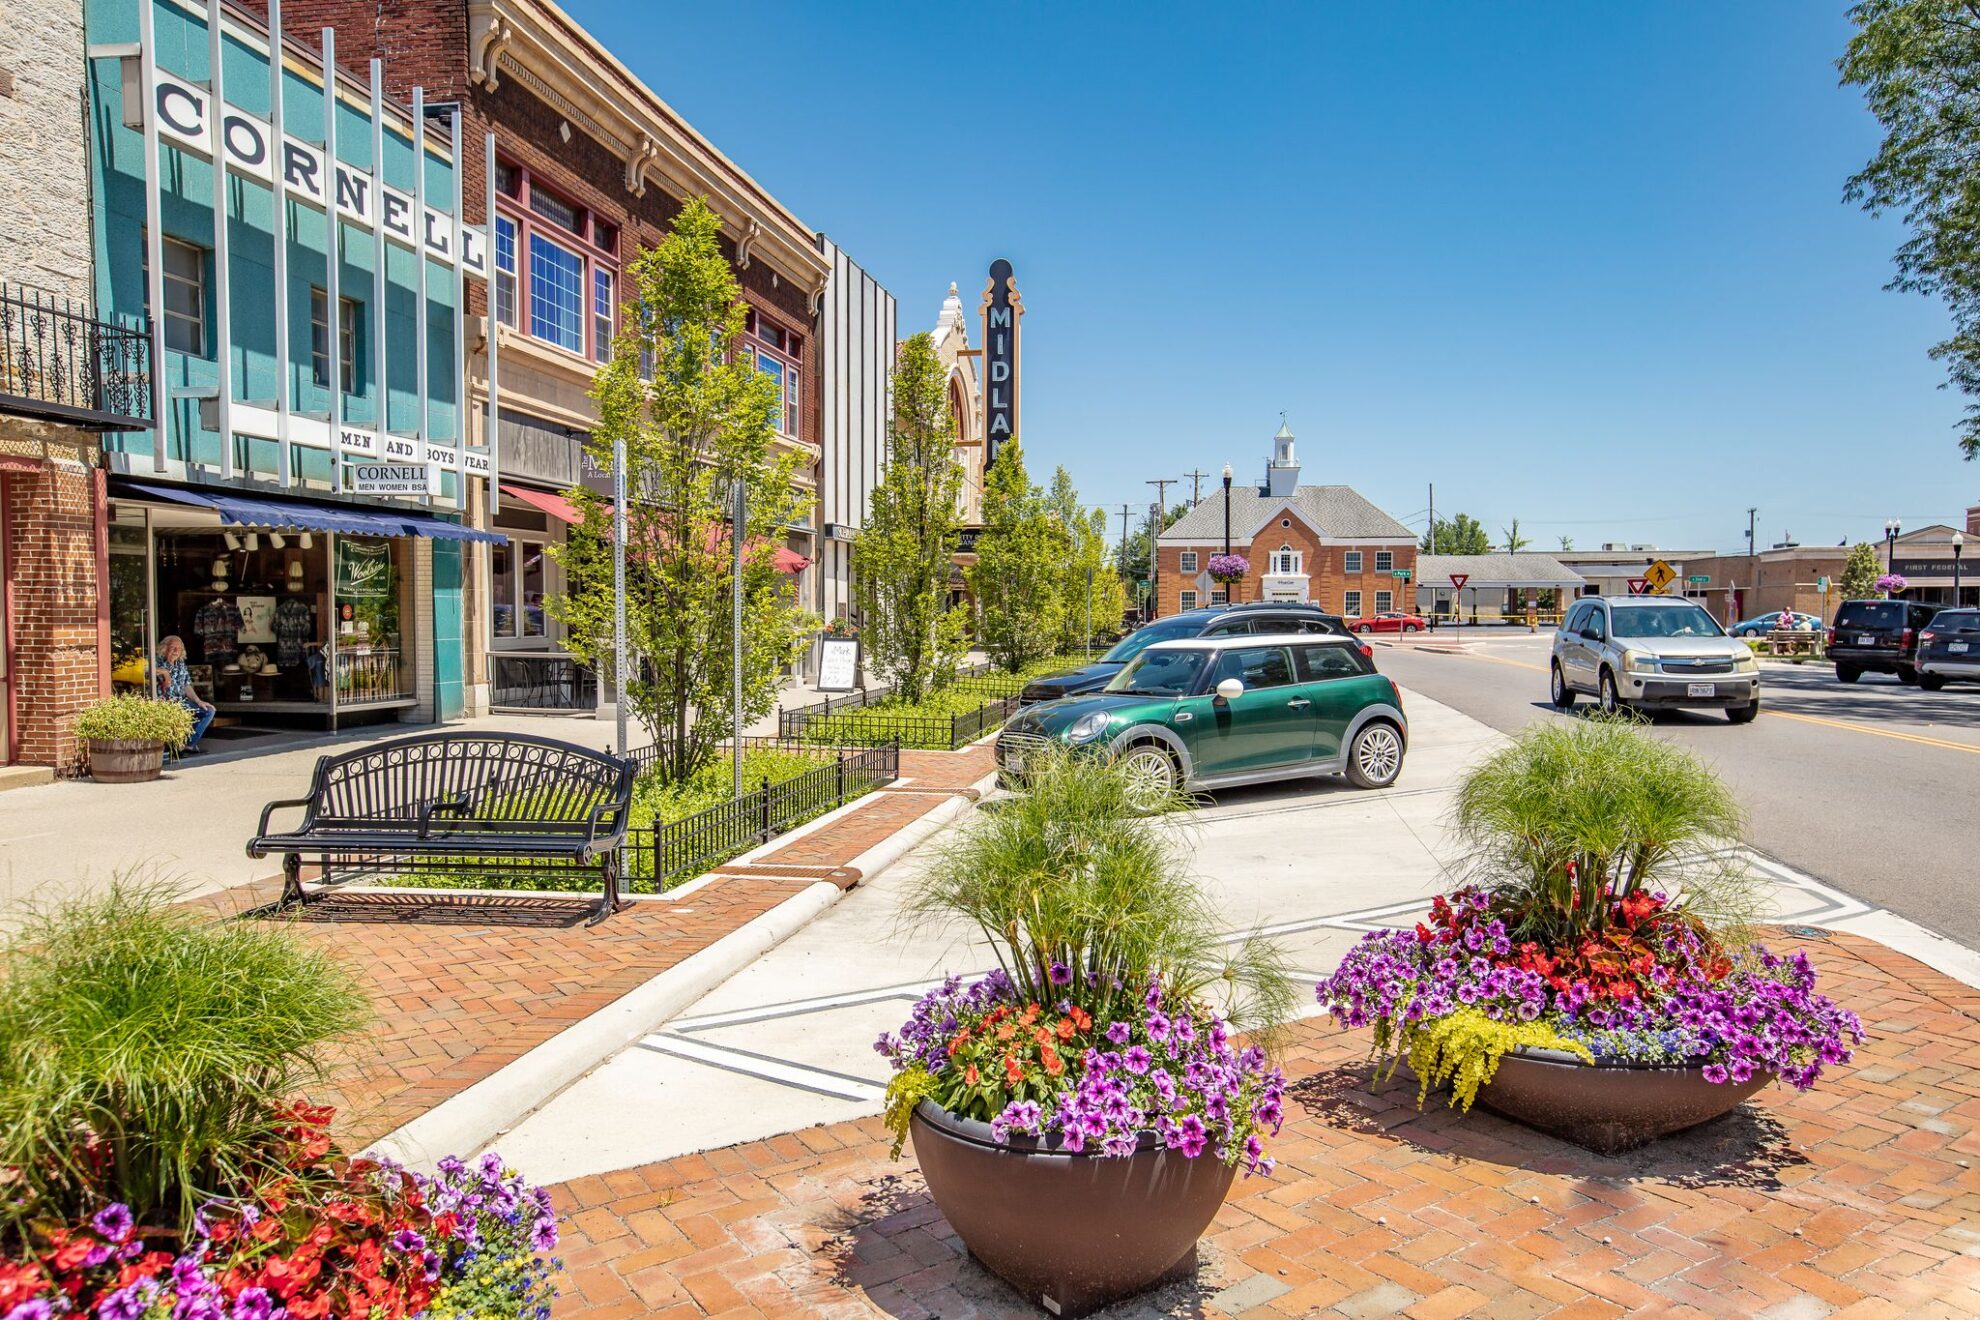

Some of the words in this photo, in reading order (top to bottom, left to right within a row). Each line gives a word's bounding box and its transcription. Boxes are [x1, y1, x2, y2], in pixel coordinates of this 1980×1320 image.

[156, 82, 484, 271] CORNELL
[340, 431, 371, 449] MEN
[386, 440, 414, 456] AND
[357, 466, 428, 481] CORNELL
[358, 483, 375, 491] MEN
[378, 483, 408, 491] WOMEN
[411, 483, 428, 491] BSA
